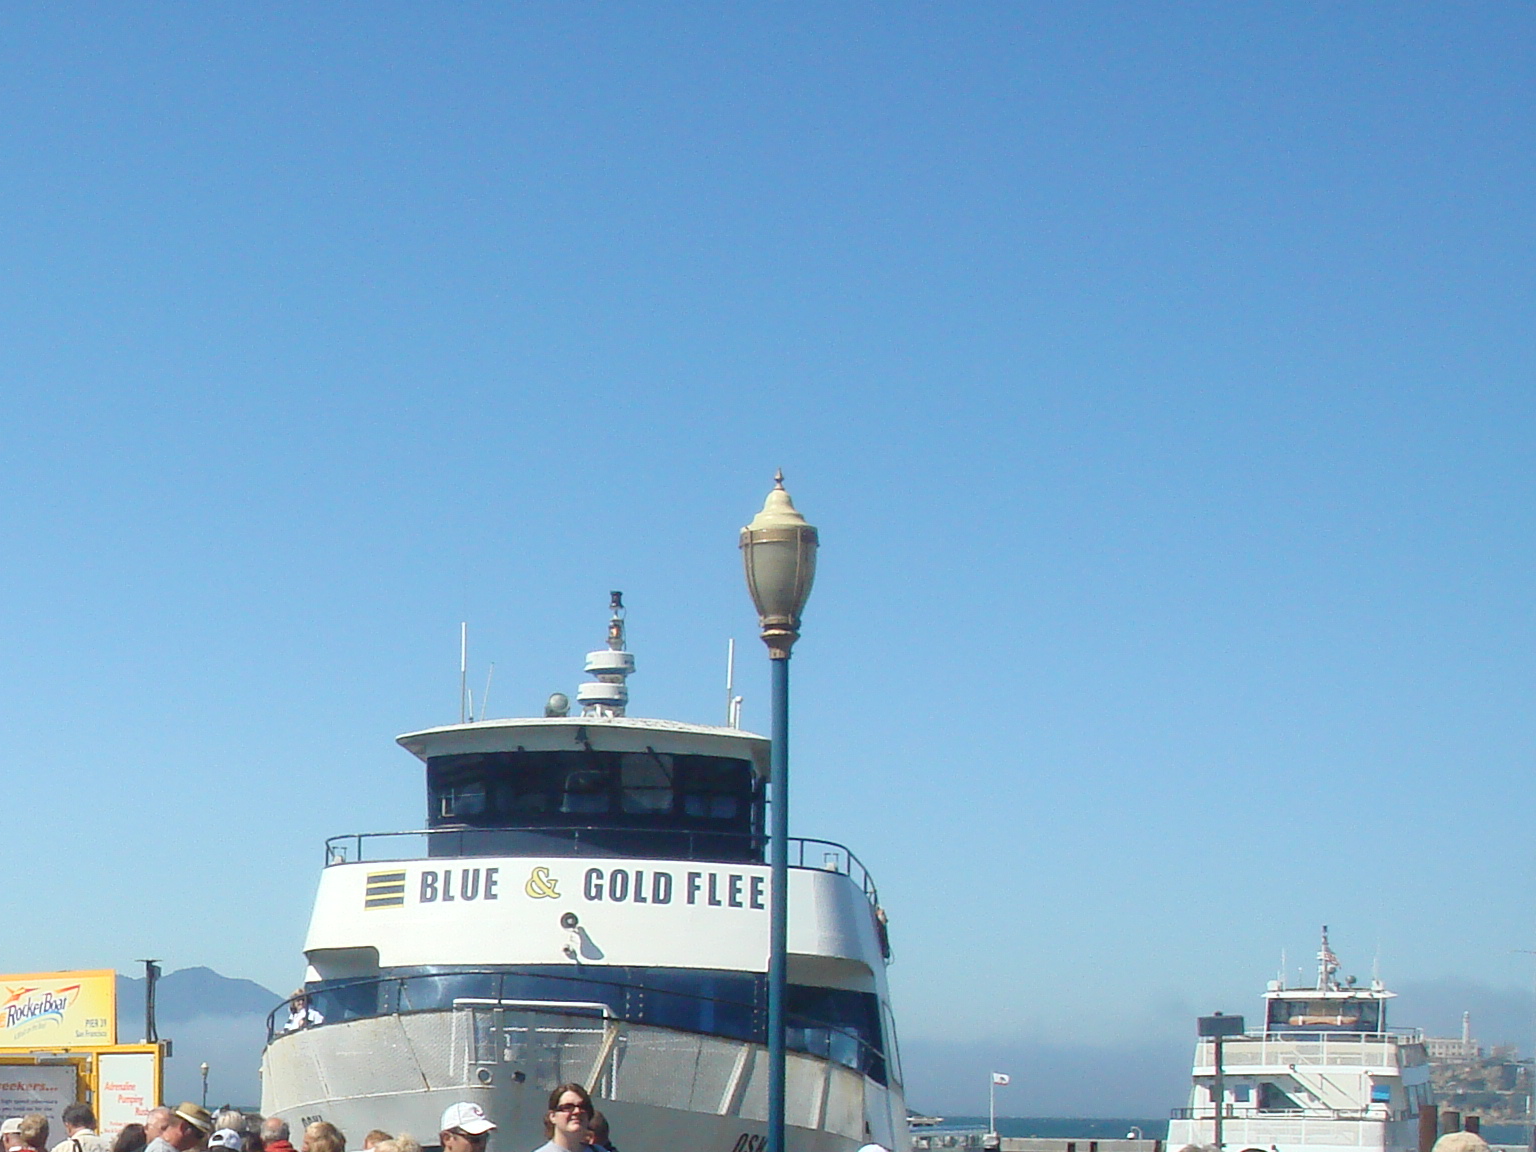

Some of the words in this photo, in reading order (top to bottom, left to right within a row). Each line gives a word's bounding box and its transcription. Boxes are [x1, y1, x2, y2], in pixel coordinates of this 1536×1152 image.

[419, 867, 500, 904] BLUE
[524, 866, 561, 899] &
[582, 868, 673, 905] GOLD
[686, 872, 765, 910] FLEE
